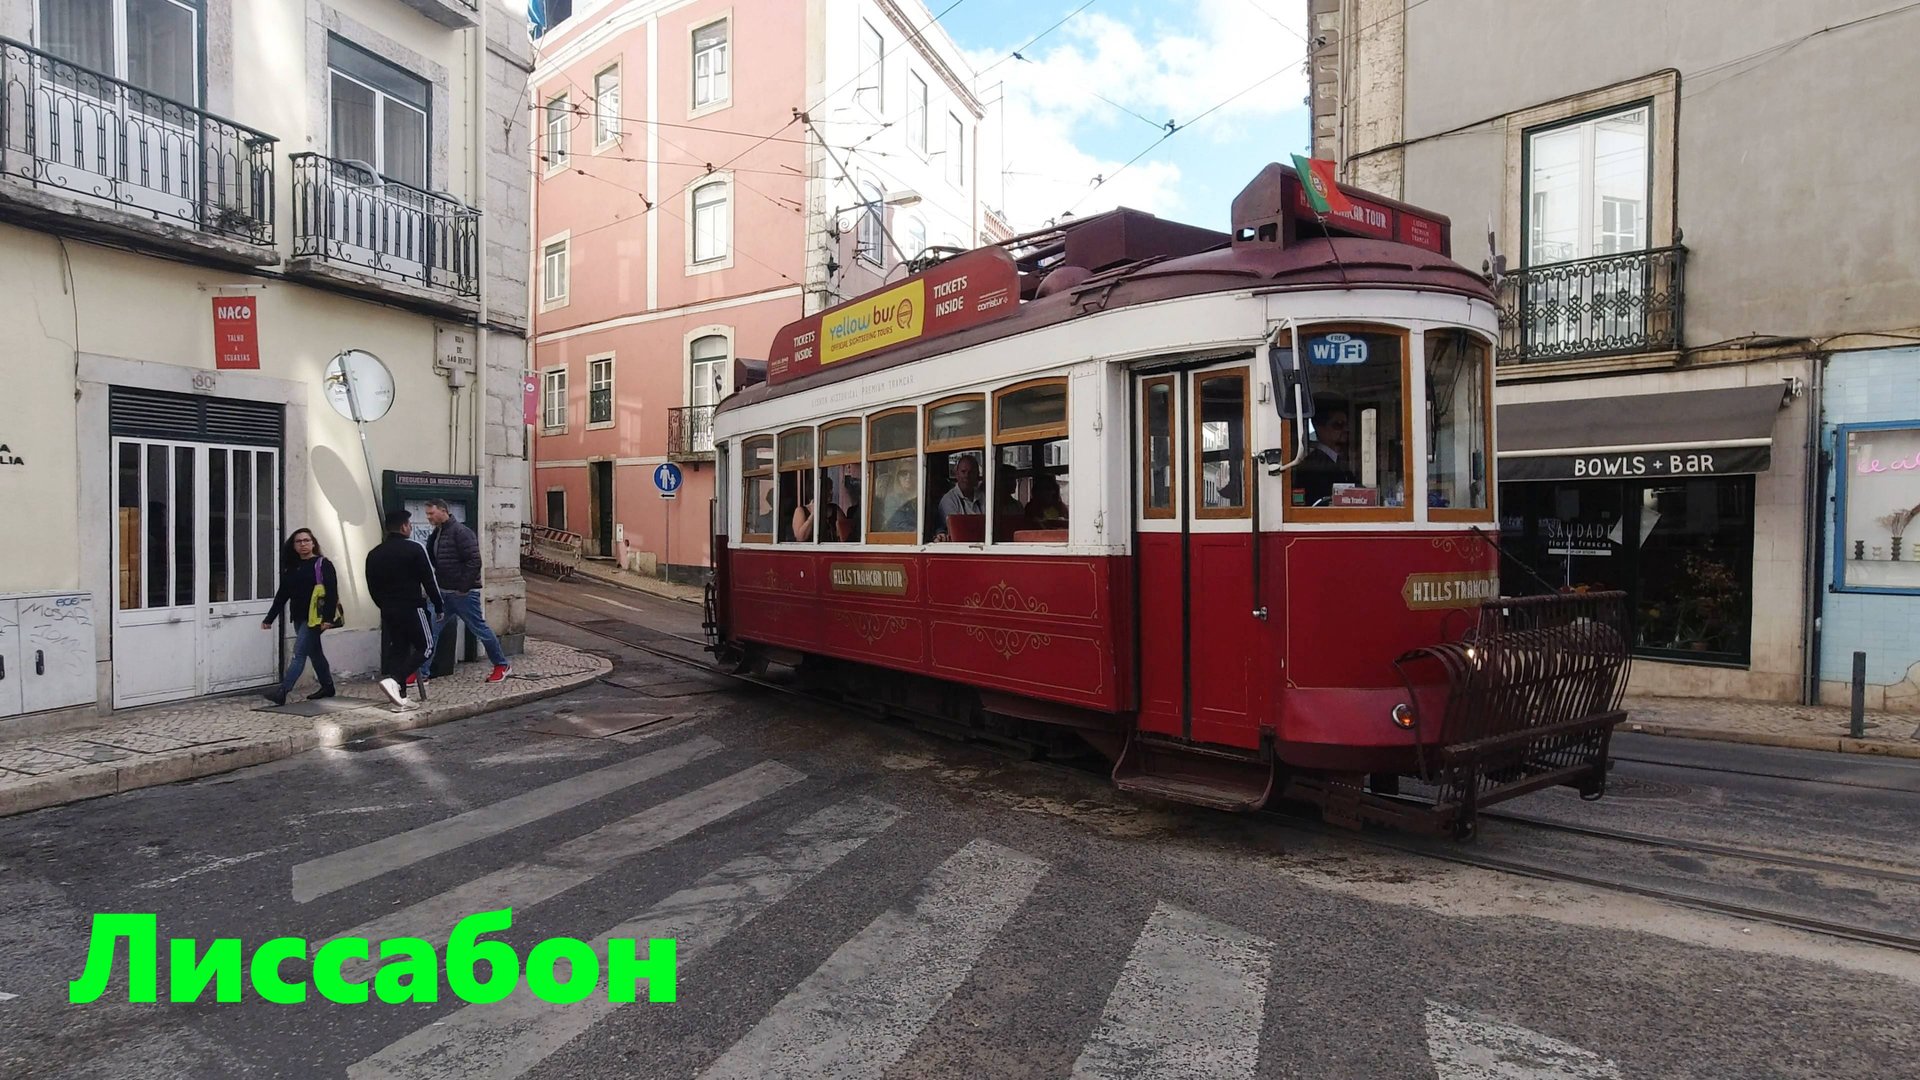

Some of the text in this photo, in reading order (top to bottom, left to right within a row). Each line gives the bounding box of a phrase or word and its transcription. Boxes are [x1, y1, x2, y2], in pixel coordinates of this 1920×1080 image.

[1366, 208, 1387, 229] TOUR
[934, 276, 967, 299] TICKETS
[936, 296, 964, 317] INSIDE
[829, 305, 895, 341] yellow bus
[877, 326, 893, 338] TOURS
[455, 335, 464, 343] RUA
[793, 331, 816, 348] TICKETS
[794, 347, 813, 362] INSIDE
[195, 374, 213, 388] 80
[1574, 456, 1646, 476] BOWLS
[1652, 460, 1663, 469] +
[398, 476, 429, 484] FREGUESIA
[833, 569, 852, 585] HILLS
[883, 570, 903, 587] TOUR
[1413, 581, 1452, 601] HILLS
